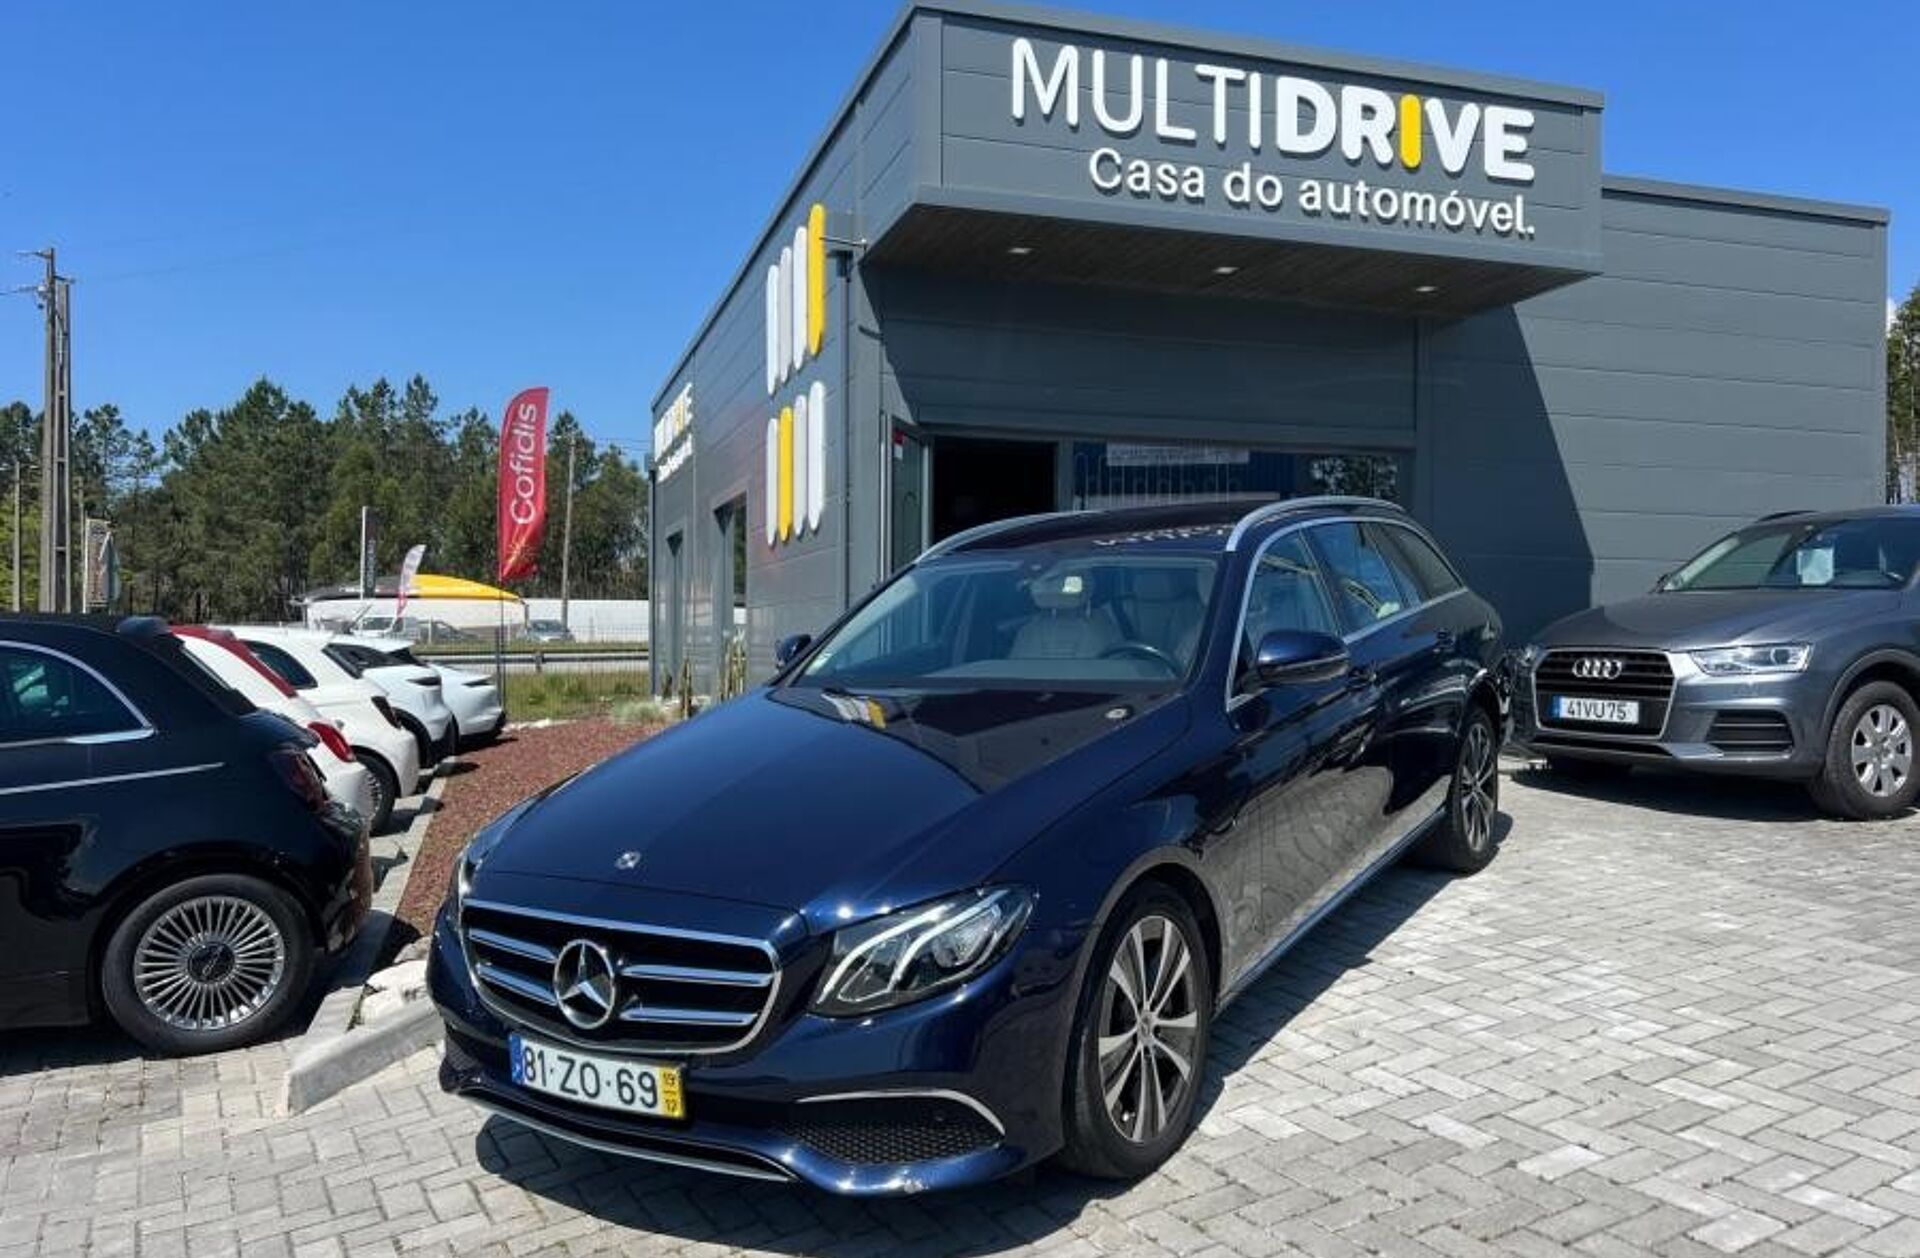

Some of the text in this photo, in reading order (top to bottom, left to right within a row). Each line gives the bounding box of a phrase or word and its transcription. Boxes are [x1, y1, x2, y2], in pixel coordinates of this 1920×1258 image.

[1012, 38, 1535, 181] MULTIDRIVE
[1089, 147, 1535, 235] Casa do automóvel.
[509, 403, 537, 525] Cofidis
